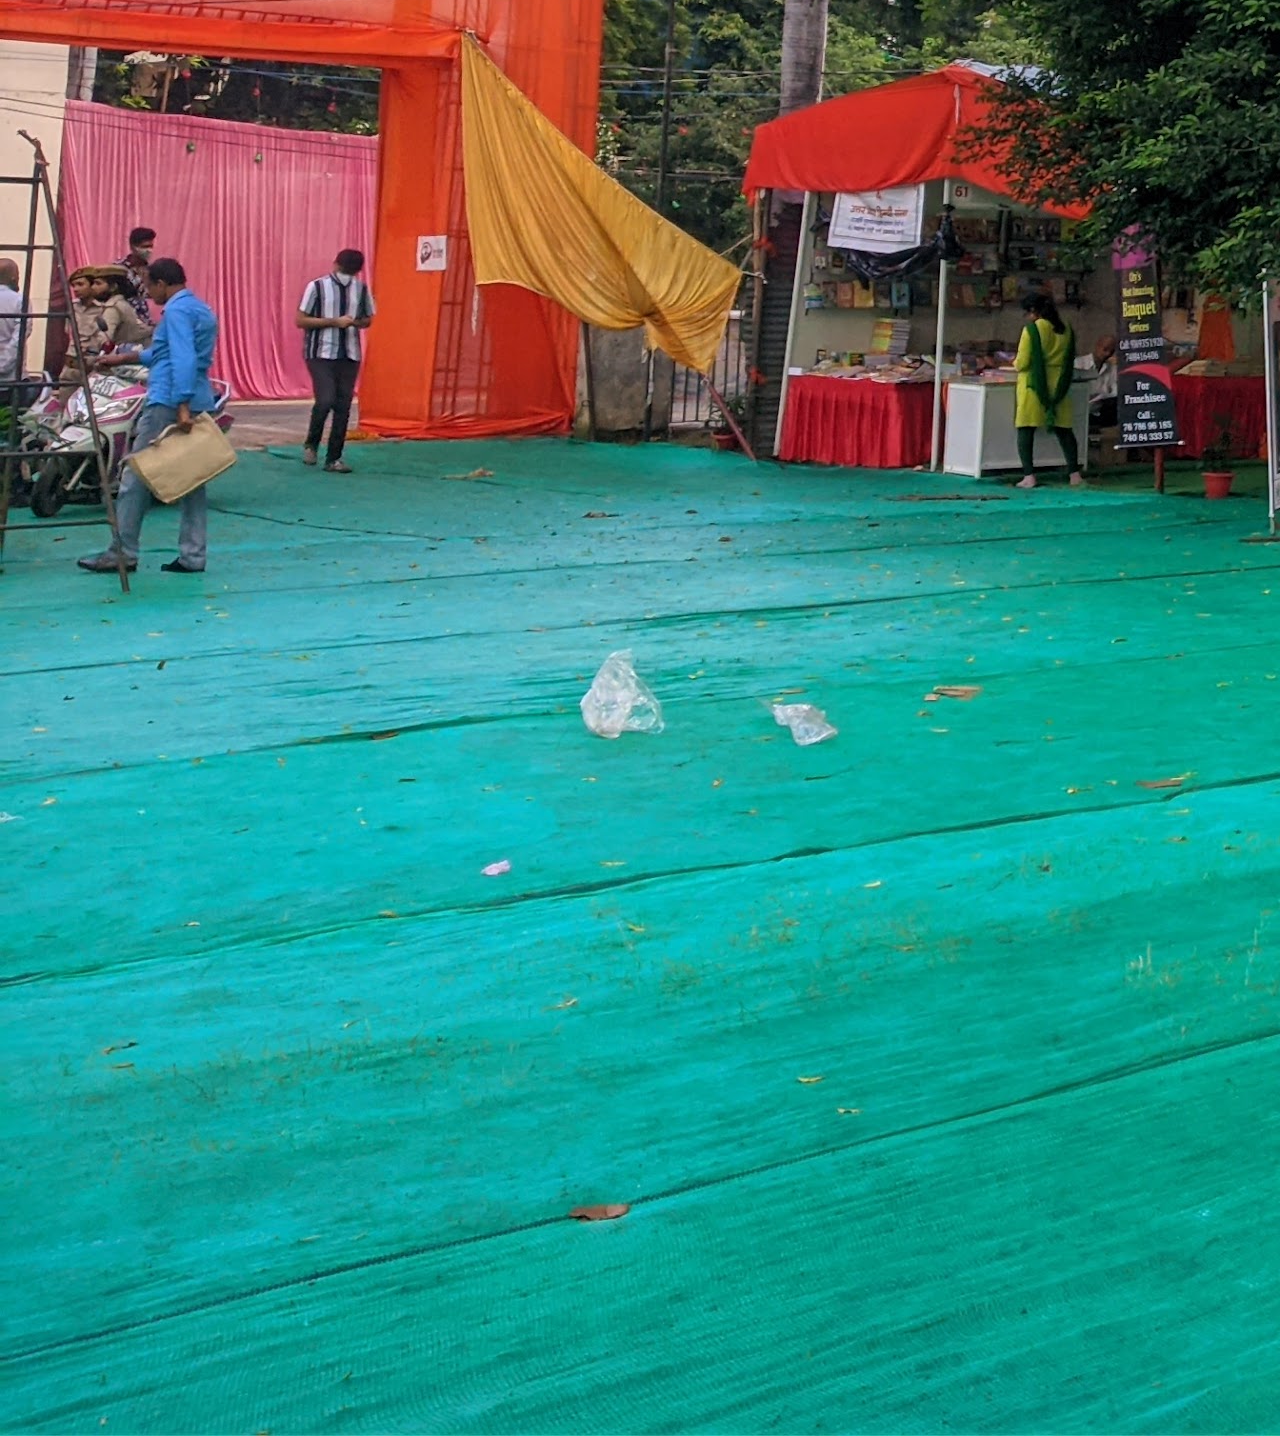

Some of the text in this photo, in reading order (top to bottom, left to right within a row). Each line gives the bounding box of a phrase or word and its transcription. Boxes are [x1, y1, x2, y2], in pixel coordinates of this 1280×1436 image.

[954, 186, 968, 198] 61
[1122, 300, 1156, 320] Banquet
[1136, 382, 1150, 391] For
[1124, 393, 1166, 404] Franchisee
